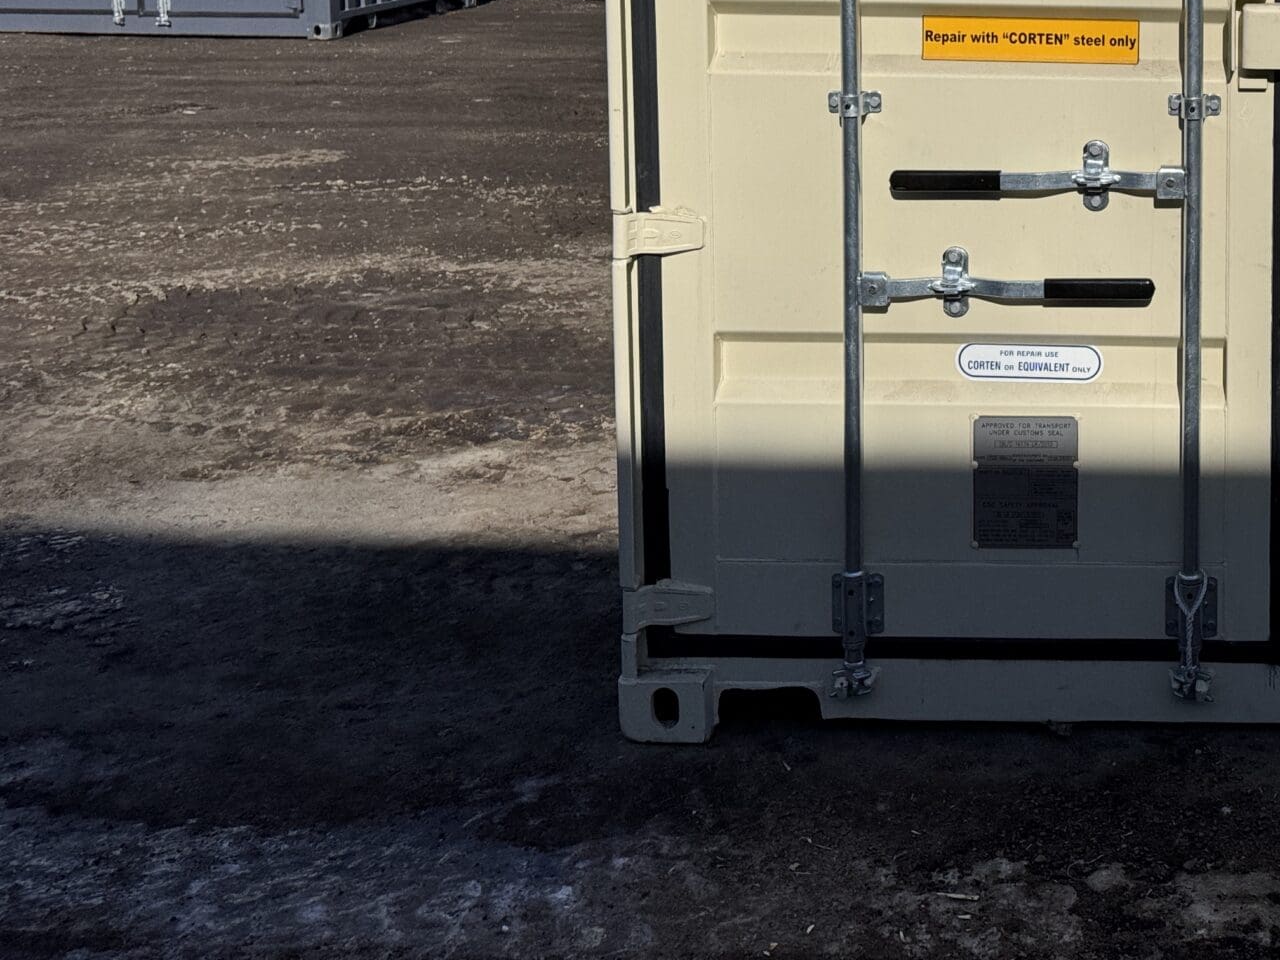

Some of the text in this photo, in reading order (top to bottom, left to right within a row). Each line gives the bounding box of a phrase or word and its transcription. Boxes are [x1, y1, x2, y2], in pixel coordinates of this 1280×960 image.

[925, 30, 967, 45] Repair
[971, 31, 999, 44] with
[1073, 34, 1105, 46] steel
[1109, 35, 1137, 50] only
[967, 360, 1001, 370] CORTEN
[1018, 361, 1070, 372] EQUIVALENT
